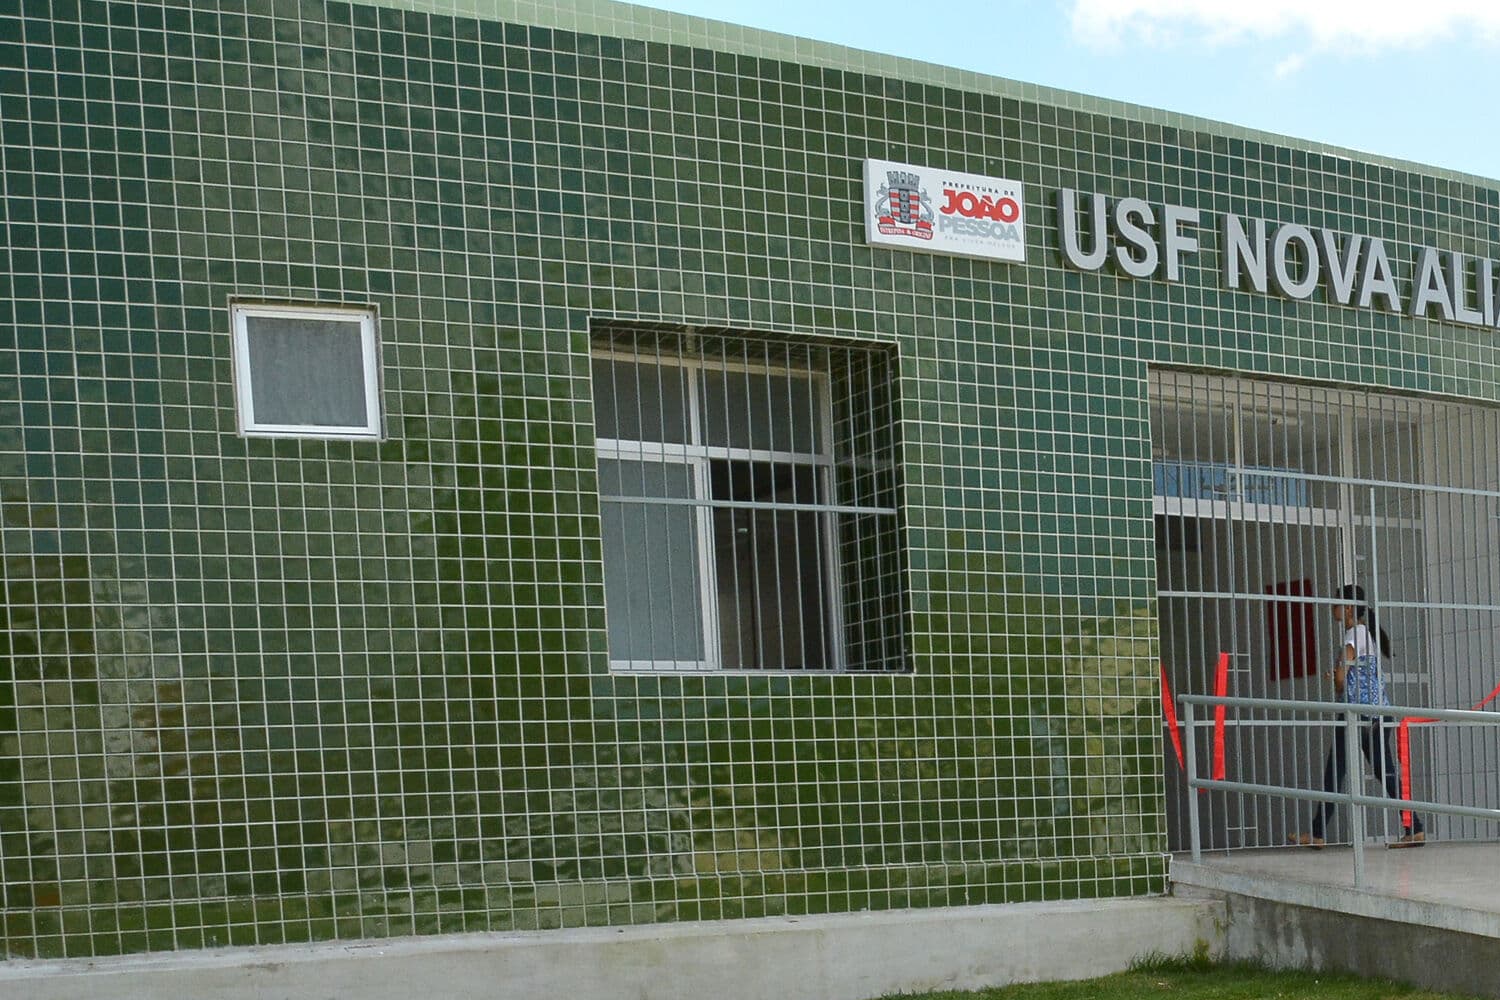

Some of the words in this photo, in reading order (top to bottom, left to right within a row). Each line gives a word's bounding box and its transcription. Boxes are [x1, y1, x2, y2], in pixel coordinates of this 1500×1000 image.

[942, 181, 999, 194] PREFEITURA
[939, 189, 1019, 223] JOÃO
[938, 214, 1021, 242] PESSOA
[1057, 187, 1199, 282] USF
[1222, 213, 1402, 313] NOVA
